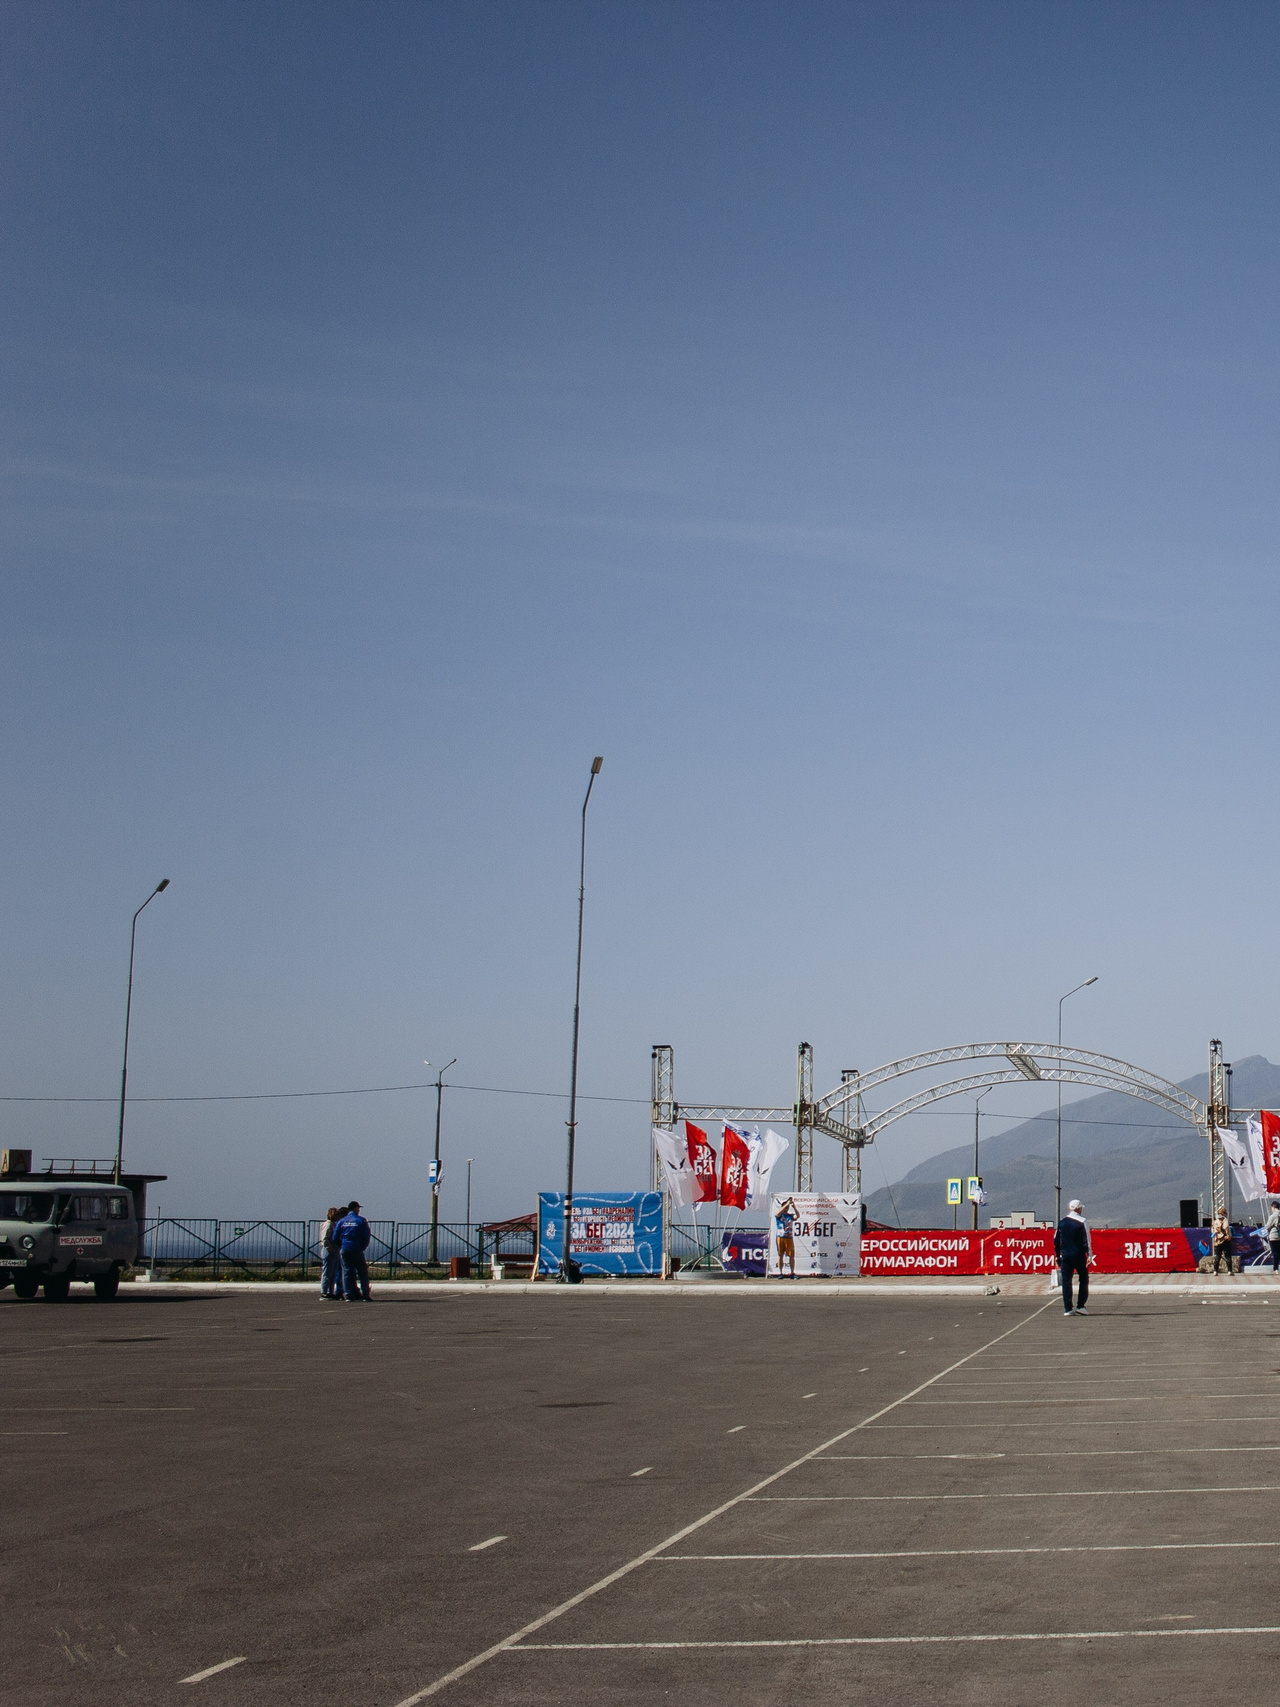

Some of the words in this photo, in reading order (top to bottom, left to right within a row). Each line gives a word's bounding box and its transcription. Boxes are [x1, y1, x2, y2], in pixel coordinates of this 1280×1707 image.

[695, 1145, 712, 1160] ЗА
[694, 1160, 715, 1176] БЕГ
[726, 1168, 746, 1188] БЕГ
[998, 1220, 1004, 1229] 2
[1020, 1217, 1025, 1226] 1
[794, 1222, 810, 1237] ЗА
[814, 1222, 837, 1237] БЕГ
[861, 1237, 969, 1251] ЕРОССИЙСКИЙ
[994, 1240, 1004, 1248] о.
[1006, 1238, 1044, 1249] Итуруп
[1124, 1242, 1143, 1259] ЗА
[1146, 1241, 1172, 1259] БЕГ
[861, 1255, 957, 1268] ЛУМАРАФОН
[993, 1254, 1003, 1267] г.
